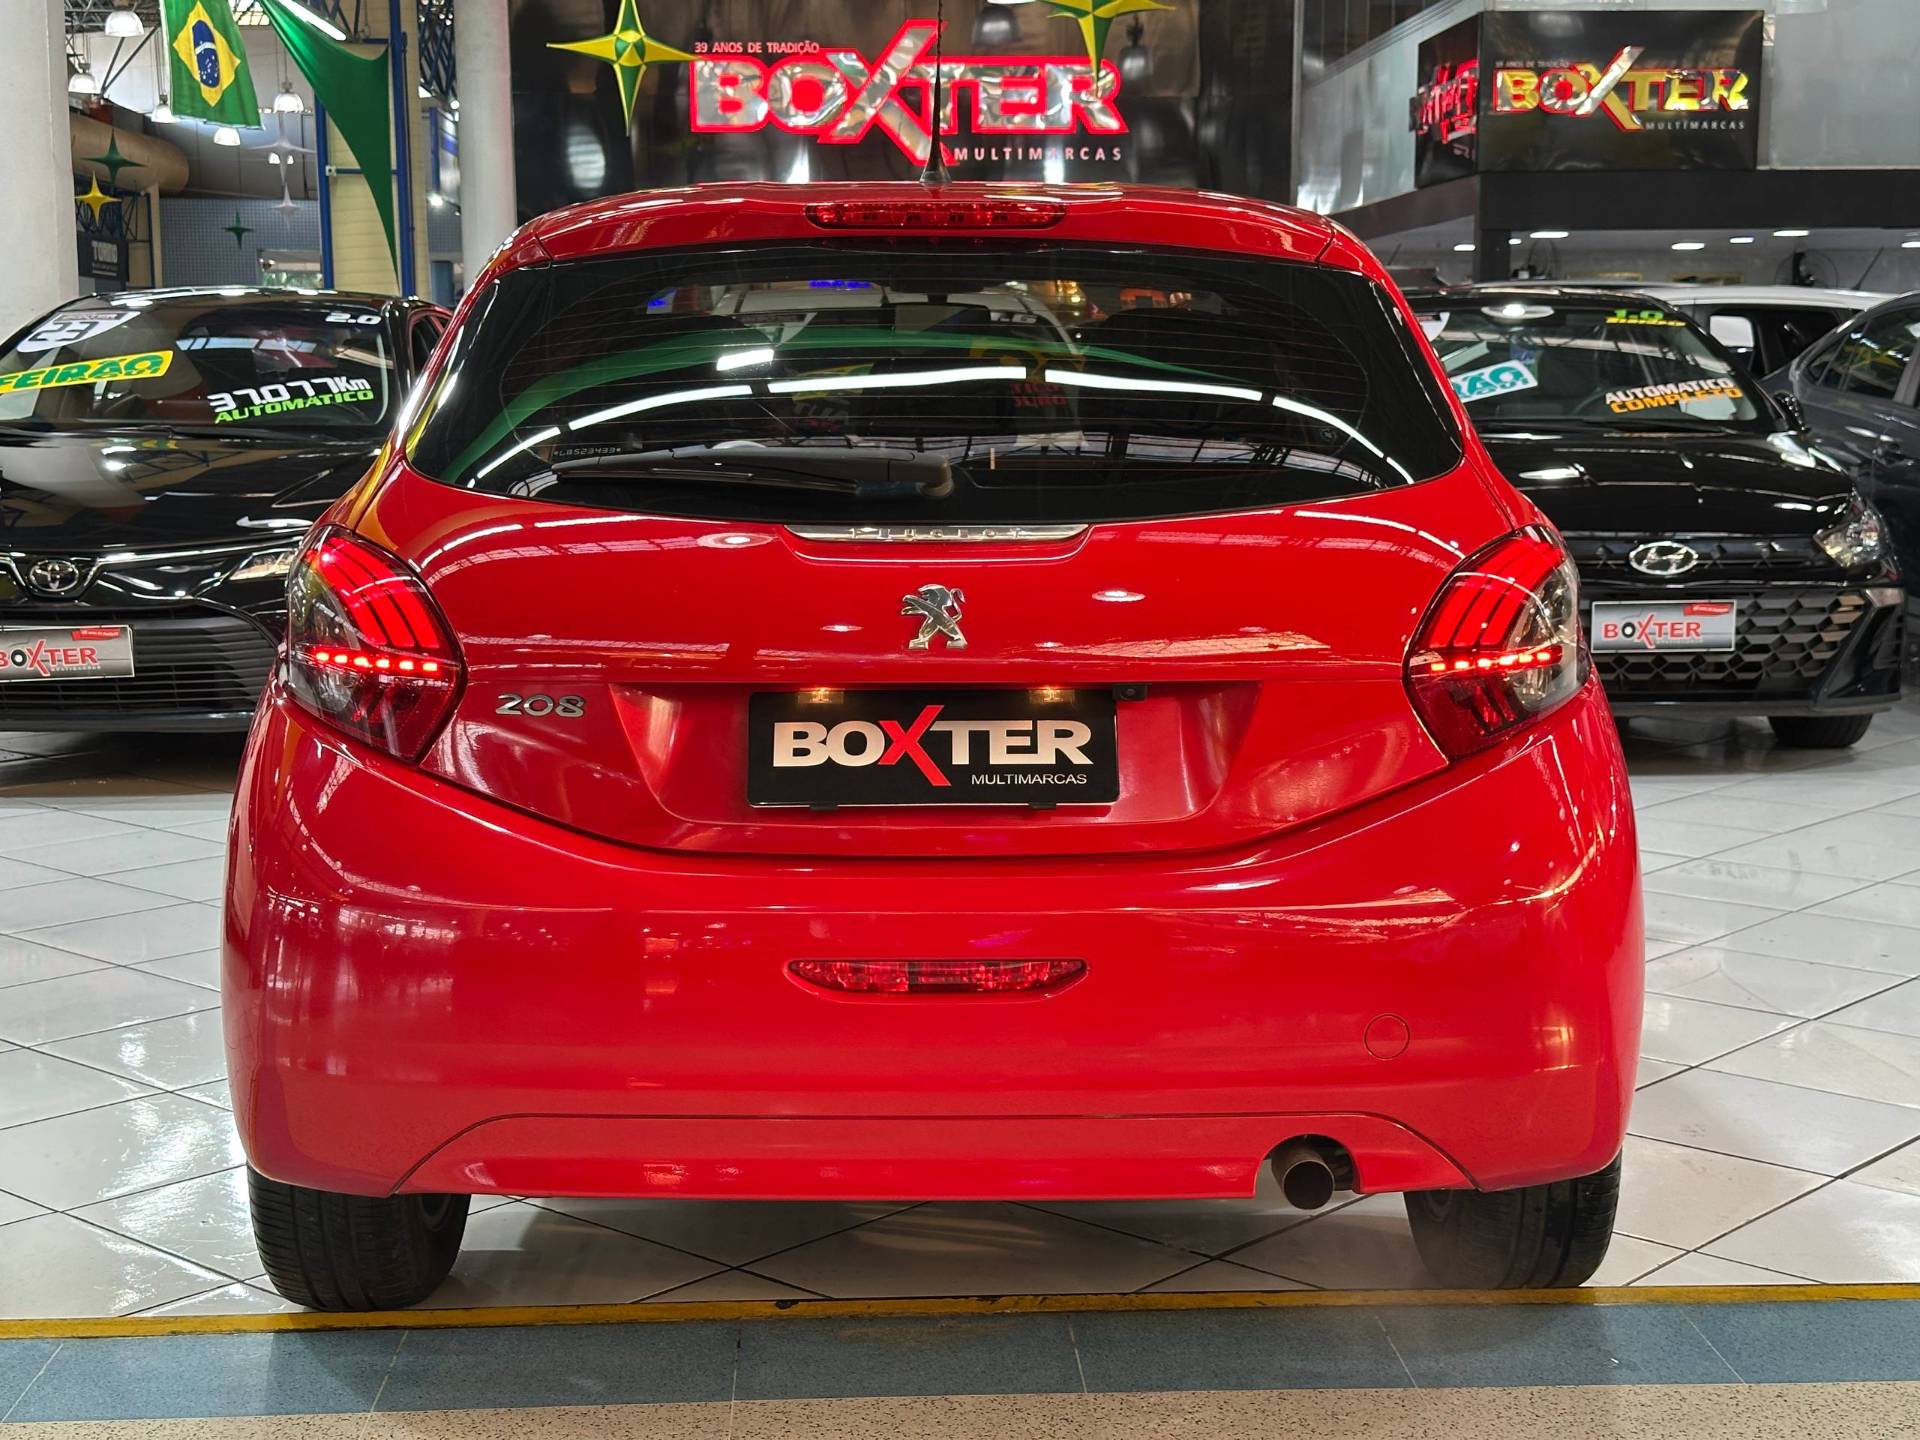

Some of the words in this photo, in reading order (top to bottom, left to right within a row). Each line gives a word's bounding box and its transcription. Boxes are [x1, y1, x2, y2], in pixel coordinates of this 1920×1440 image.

[694, 42, 708, 53] 39
[712, 42, 743, 53] ANOS
[747, 42, 763, 53] DE
[766, 40, 820, 55] TRADIÇÃO
[690, 18, 1129, 166] BOXTER
[1493, 45, 1749, 132] BOXTER
[1646, 120, 1746, 131] MULTIMARCAS
[954, 147, 1123, 162] MULTIMARCAS
[325, 312, 382, 325] 2.0
[28, 321, 99, 342] 23
[1610, 387, 1744, 414] COMPLETO
[1603, 613, 1702, 649] BOXTER
[495, 693, 585, 717] 208
[773, 705, 1094, 787] BOXTER
[971, 773, 1088, 785] MULTIMARCAS
